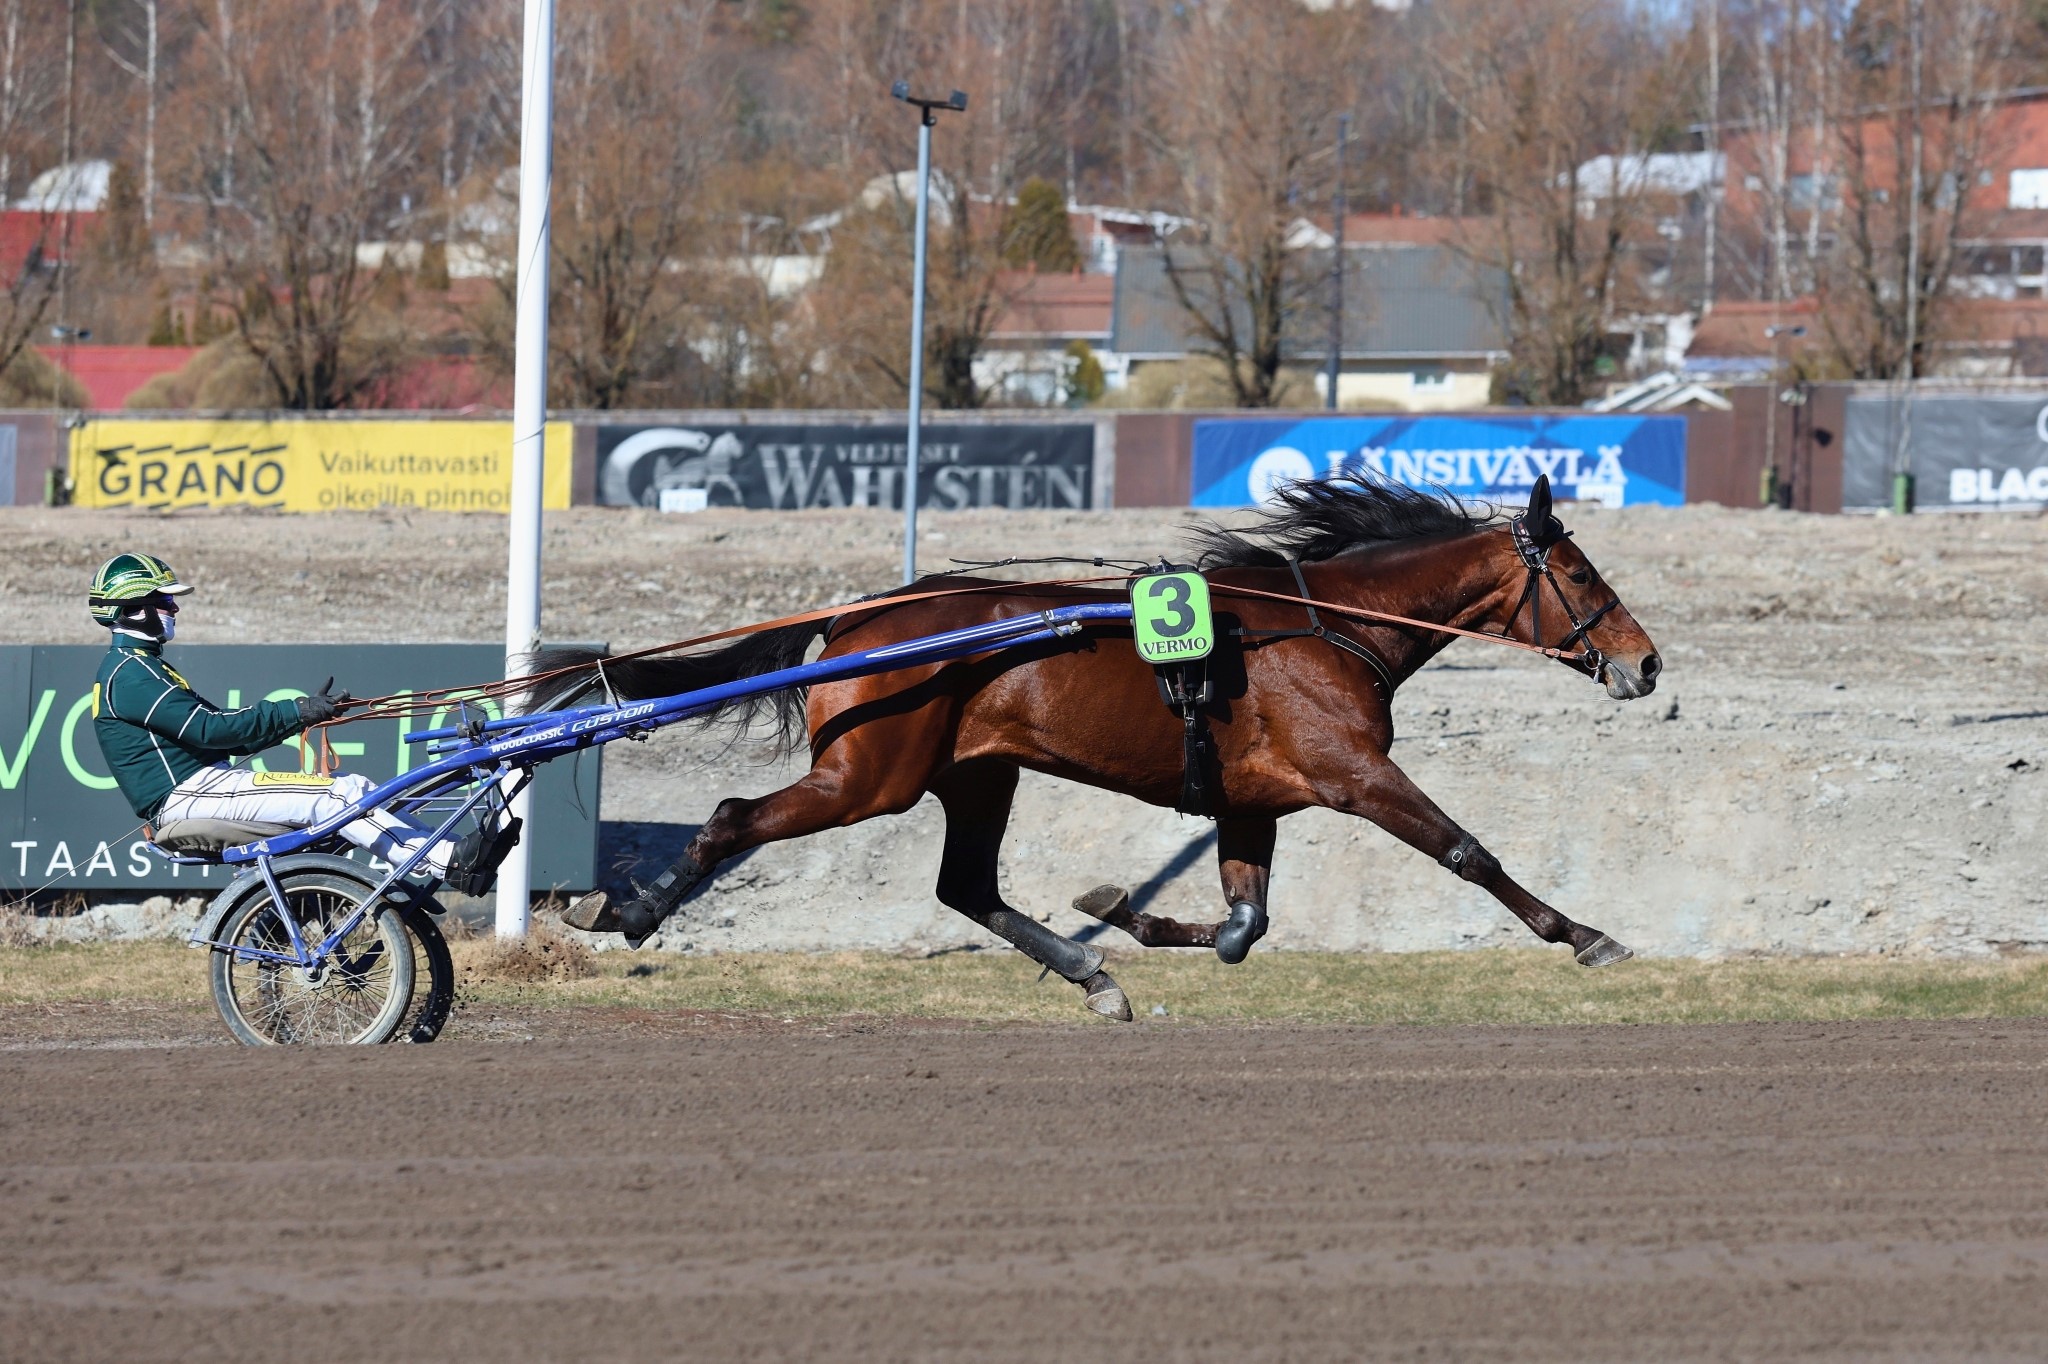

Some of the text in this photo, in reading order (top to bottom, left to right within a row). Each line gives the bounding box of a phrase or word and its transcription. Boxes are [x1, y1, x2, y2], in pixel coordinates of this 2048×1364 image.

[320, 451, 499, 475] Vaikuttavasti
[835, 442, 962, 462] VELJESET
[100, 461, 285, 498] GRANO
[318, 482, 416, 507] oikeilla
[1949, 467, 2048, 502] BLAC
[1148, 576, 1196, 638] 3
[1143, 637, 1207, 655] VERMO
[491, 703, 655, 754] WOODCLASSIC CUSTOM
